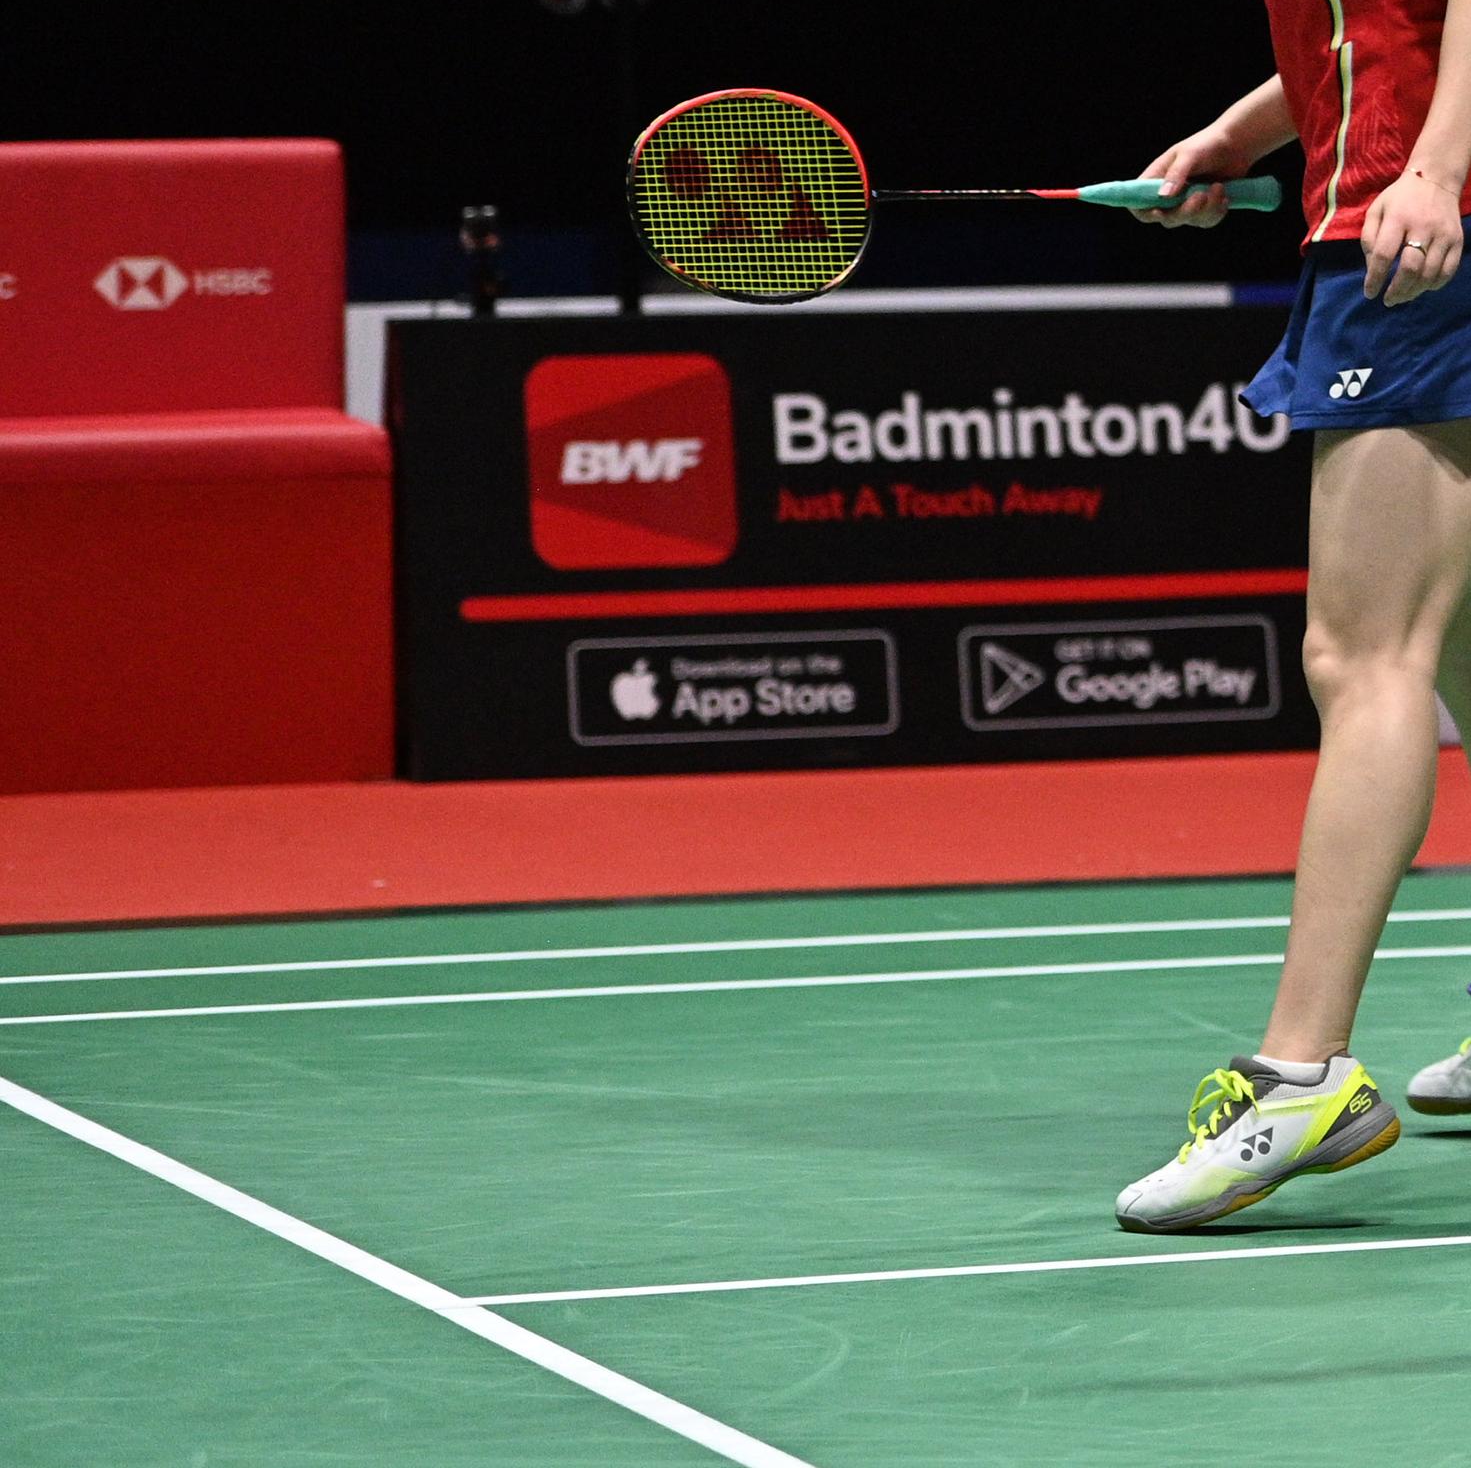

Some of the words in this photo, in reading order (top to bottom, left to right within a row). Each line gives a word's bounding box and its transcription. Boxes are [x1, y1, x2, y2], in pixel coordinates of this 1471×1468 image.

[194, 268, 273, 296] HSBC
[772, 382, 1290, 465] Badminton4U
[560, 437, 704, 485] BWF
[777, 487, 845, 522] Just
[852, 485, 884, 519] A
[892, 482, 995, 519] Touch
[1003, 481, 1102, 520] Away
[672, 681, 749, 724] App
[755, 678, 856, 715] Store
[1055, 662, 1181, 709] Google
[1184, 658, 1256, 705] Play
[1349, 1092, 1372, 1114] 65
